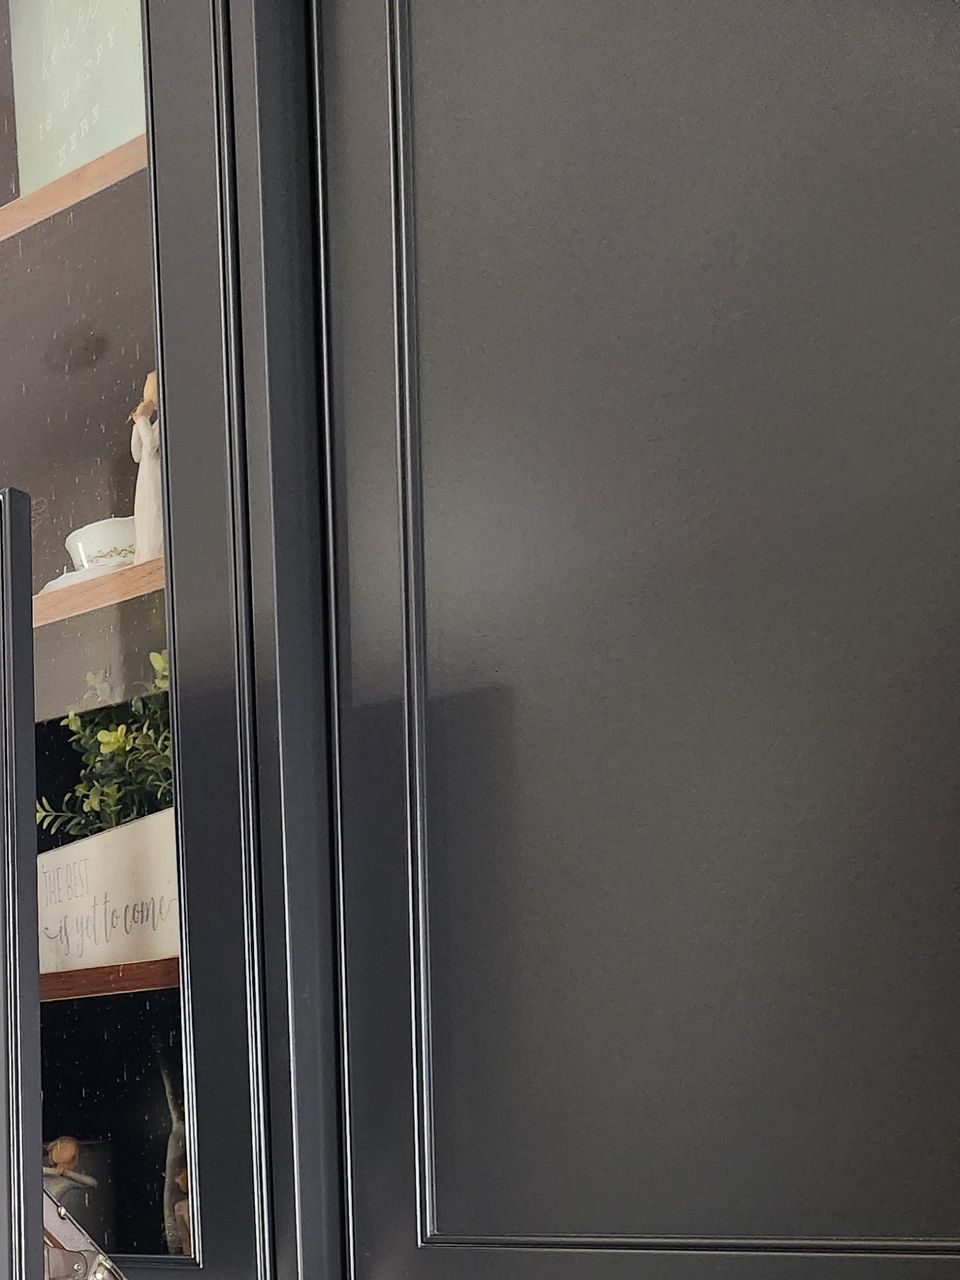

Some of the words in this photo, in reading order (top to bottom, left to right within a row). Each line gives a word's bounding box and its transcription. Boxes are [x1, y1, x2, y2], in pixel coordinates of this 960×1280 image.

[41, 866, 62, 907] THE
[66, 858, 89, 901] BEST
[102, 892, 120, 944] to
